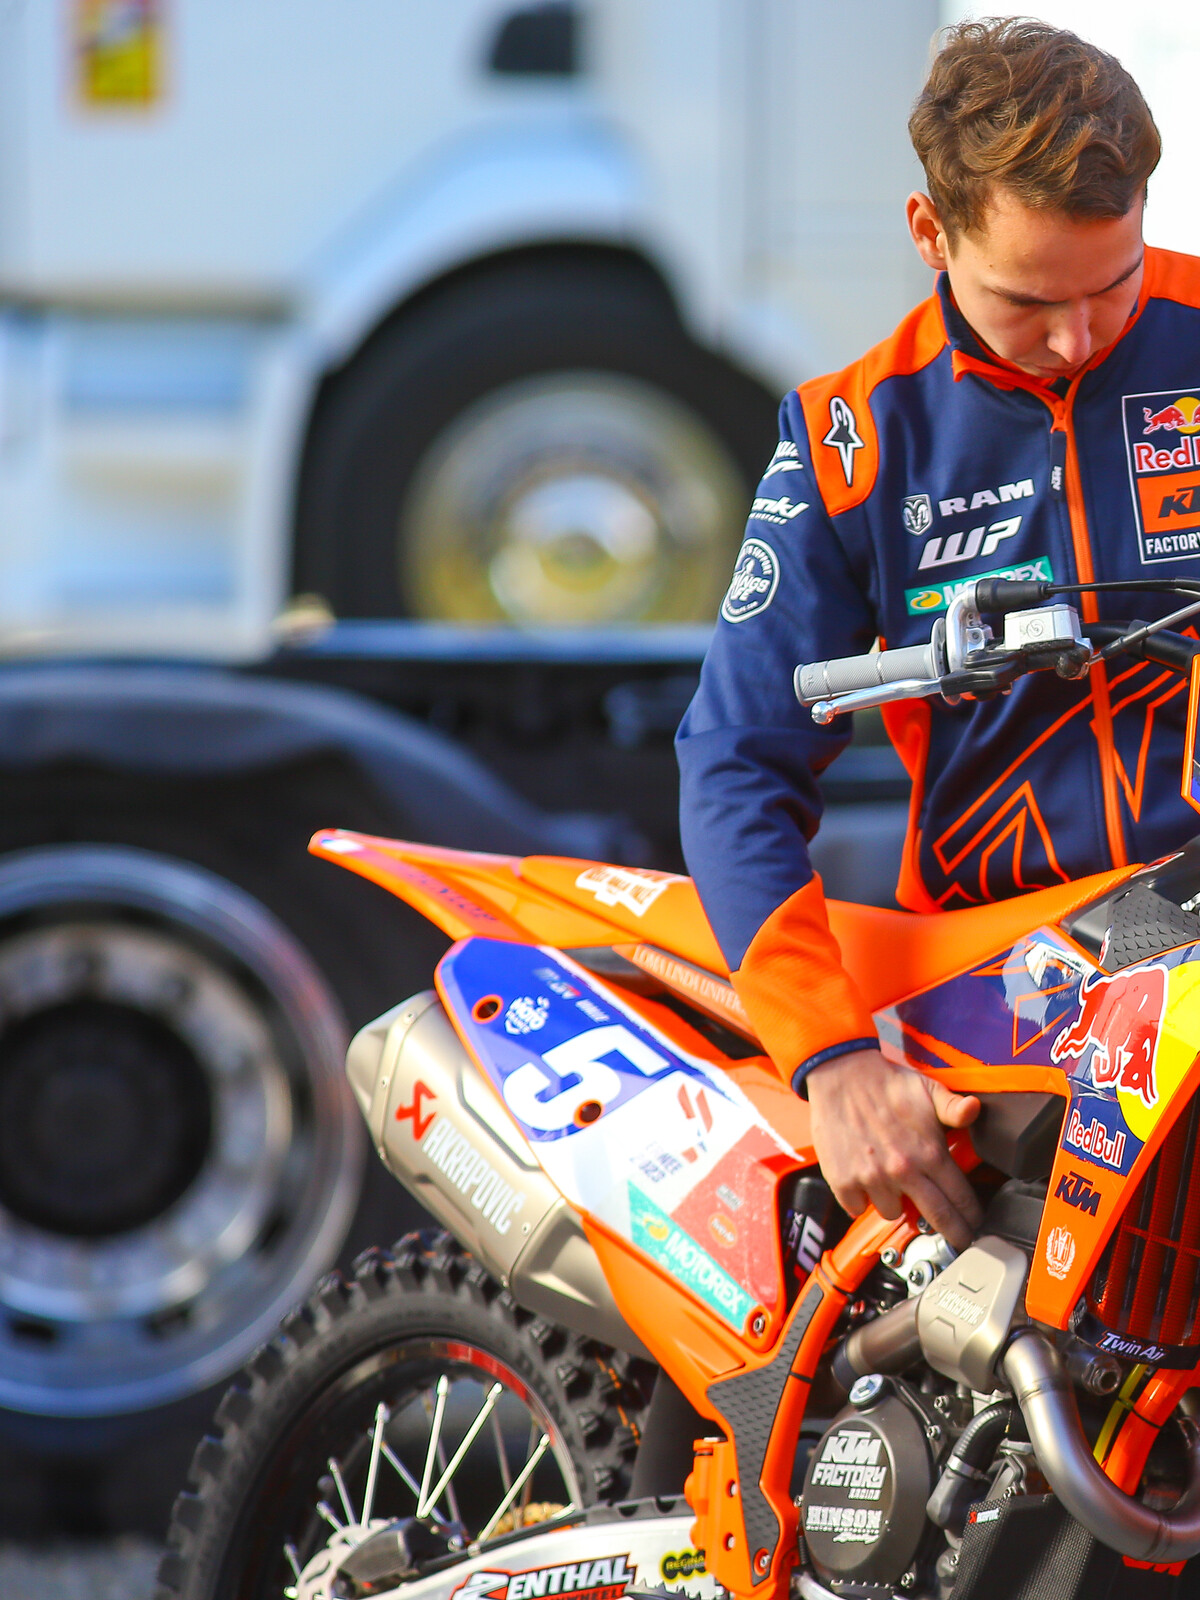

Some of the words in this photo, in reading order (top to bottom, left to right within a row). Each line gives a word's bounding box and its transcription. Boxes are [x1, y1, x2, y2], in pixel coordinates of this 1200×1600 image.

[1133, 436, 1194, 473] Red
[939, 478, 1035, 517] RAM
[699, 978, 748, 1018] UNIVER
[502, 1023, 670, 1132] 5
[1066, 1109, 1096, 1154] Red
[1091, 1121, 1127, 1168] Bull
[1054, 1171, 1102, 1217] KTM
[664, 1231, 745, 1314] MOTOREX
[1102, 1332, 1142, 1356] Twin
[821, 1430, 882, 1465] KTM
[811, 1463, 887, 1489] FACTORY
[806, 1505, 882, 1529] HINSON
[452, 1555, 637, 1600] RENTHAL
